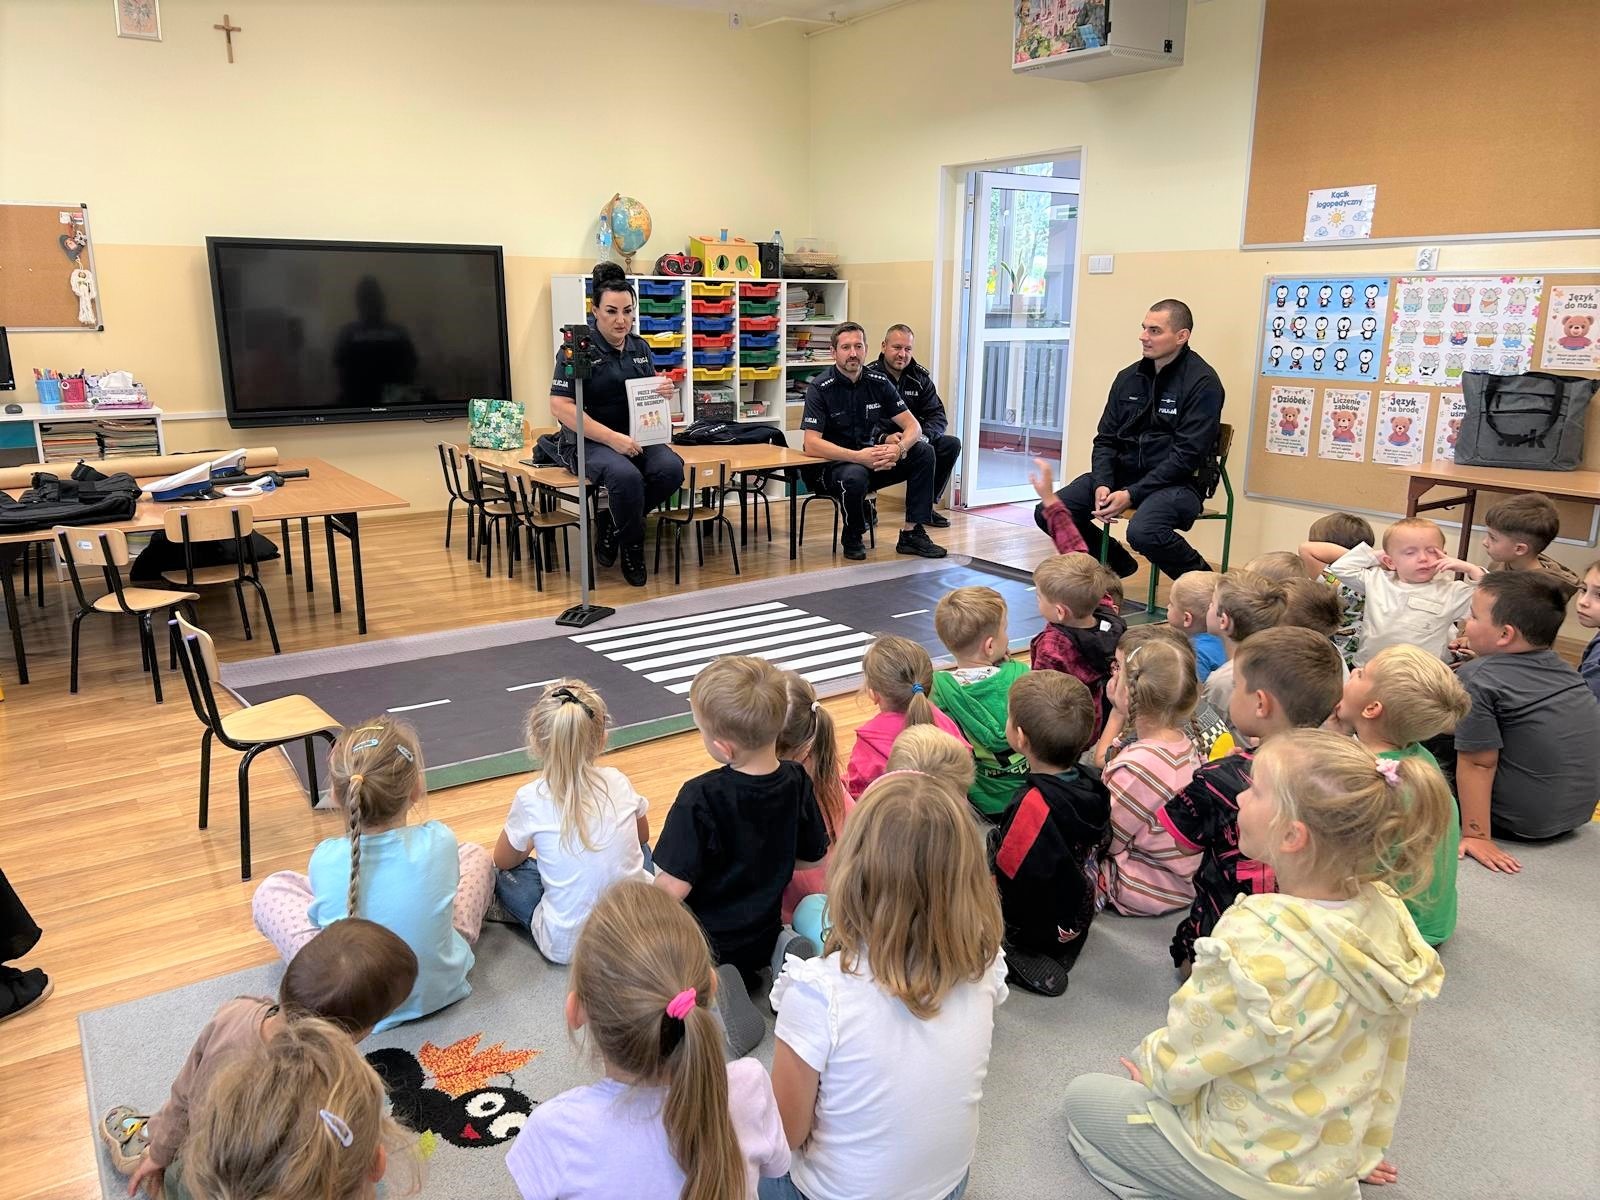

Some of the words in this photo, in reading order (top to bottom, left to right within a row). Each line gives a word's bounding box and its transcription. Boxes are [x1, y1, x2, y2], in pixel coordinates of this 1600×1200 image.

[1331, 190, 1350, 199] Kącik
[1316, 198, 1363, 209] logopedyczny
[1568, 293, 1594, 302] Język
[1277, 395, 1307, 405] Dzióbek
[1333, 397, 1361, 405] Liczenie
[1390, 397, 1417, 407] Język
[1334, 403, 1360, 411] ząbków
[1398, 406, 1420, 414] brodę
[1452, 402, 1467, 410] Sze
[1450, 410, 1466, 418] uśm
